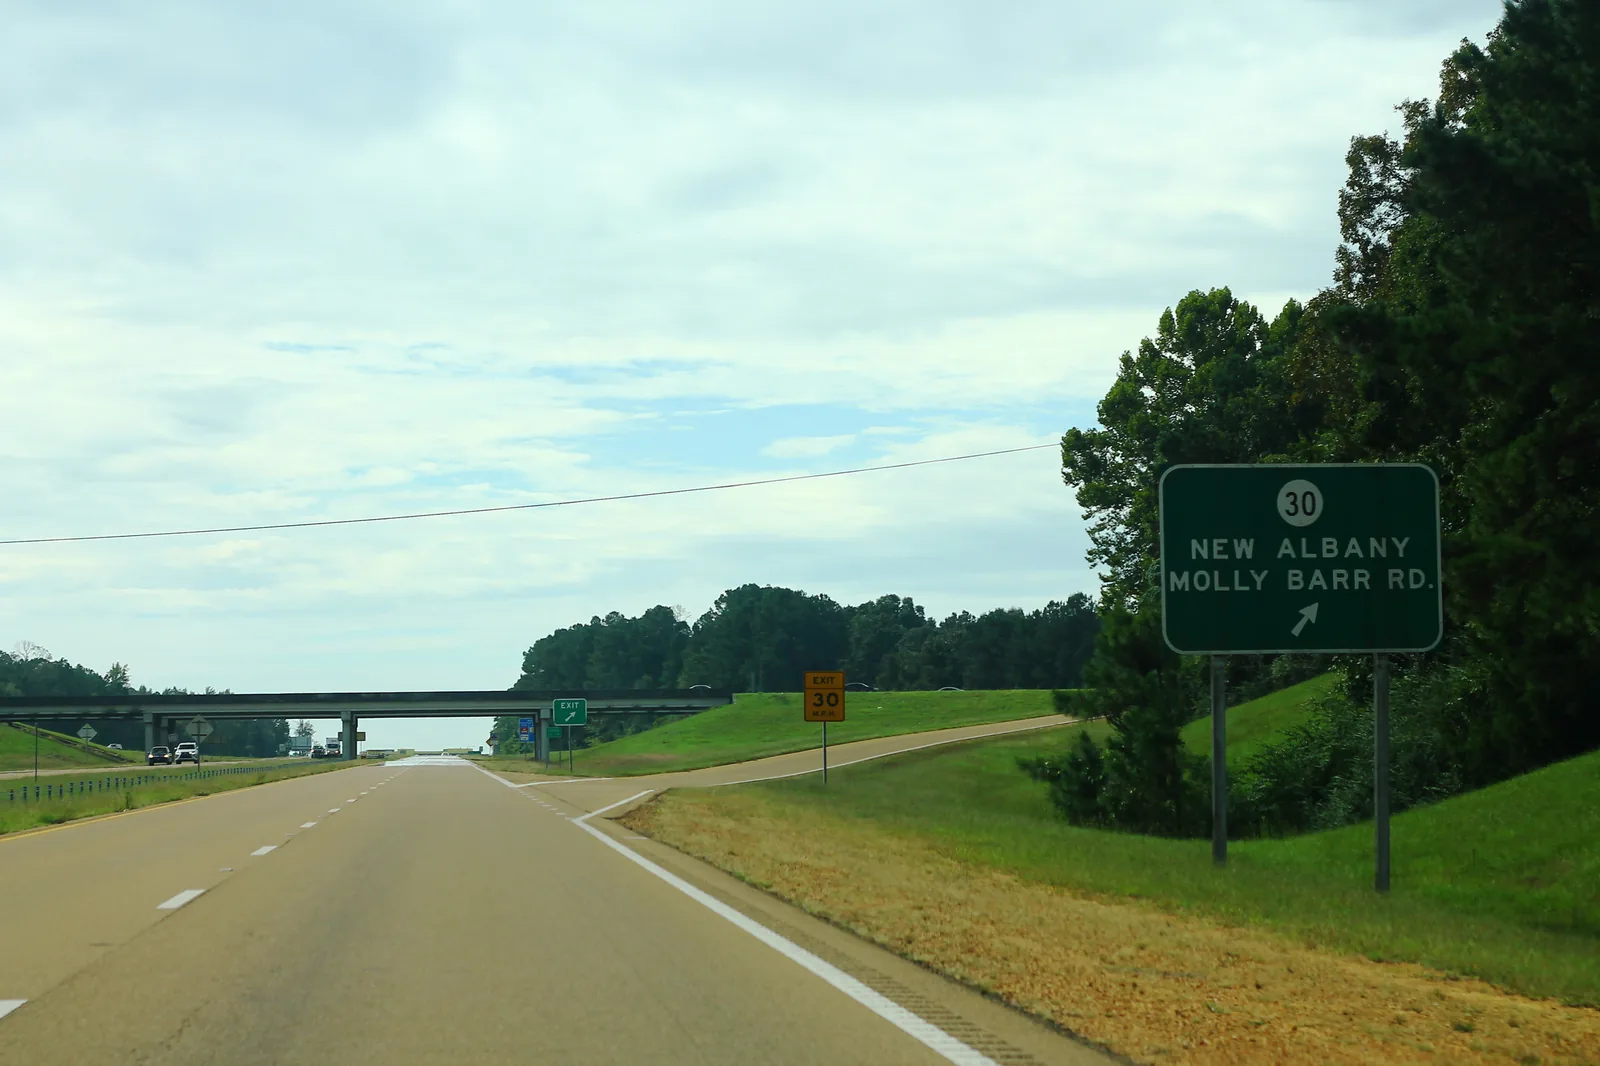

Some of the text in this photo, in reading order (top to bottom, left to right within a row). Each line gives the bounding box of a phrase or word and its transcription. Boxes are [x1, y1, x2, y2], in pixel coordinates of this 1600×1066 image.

[1285, 491, 1316, 517] 30
[1191, 536, 1411, 560] NEW ALBANY
[1170, 568, 1435, 592] MOLLY BARR RD.
[813, 676, 835, 685] EXIT
[560, 701, 580, 709] EXIT
[812, 692, 839, 707] 30
